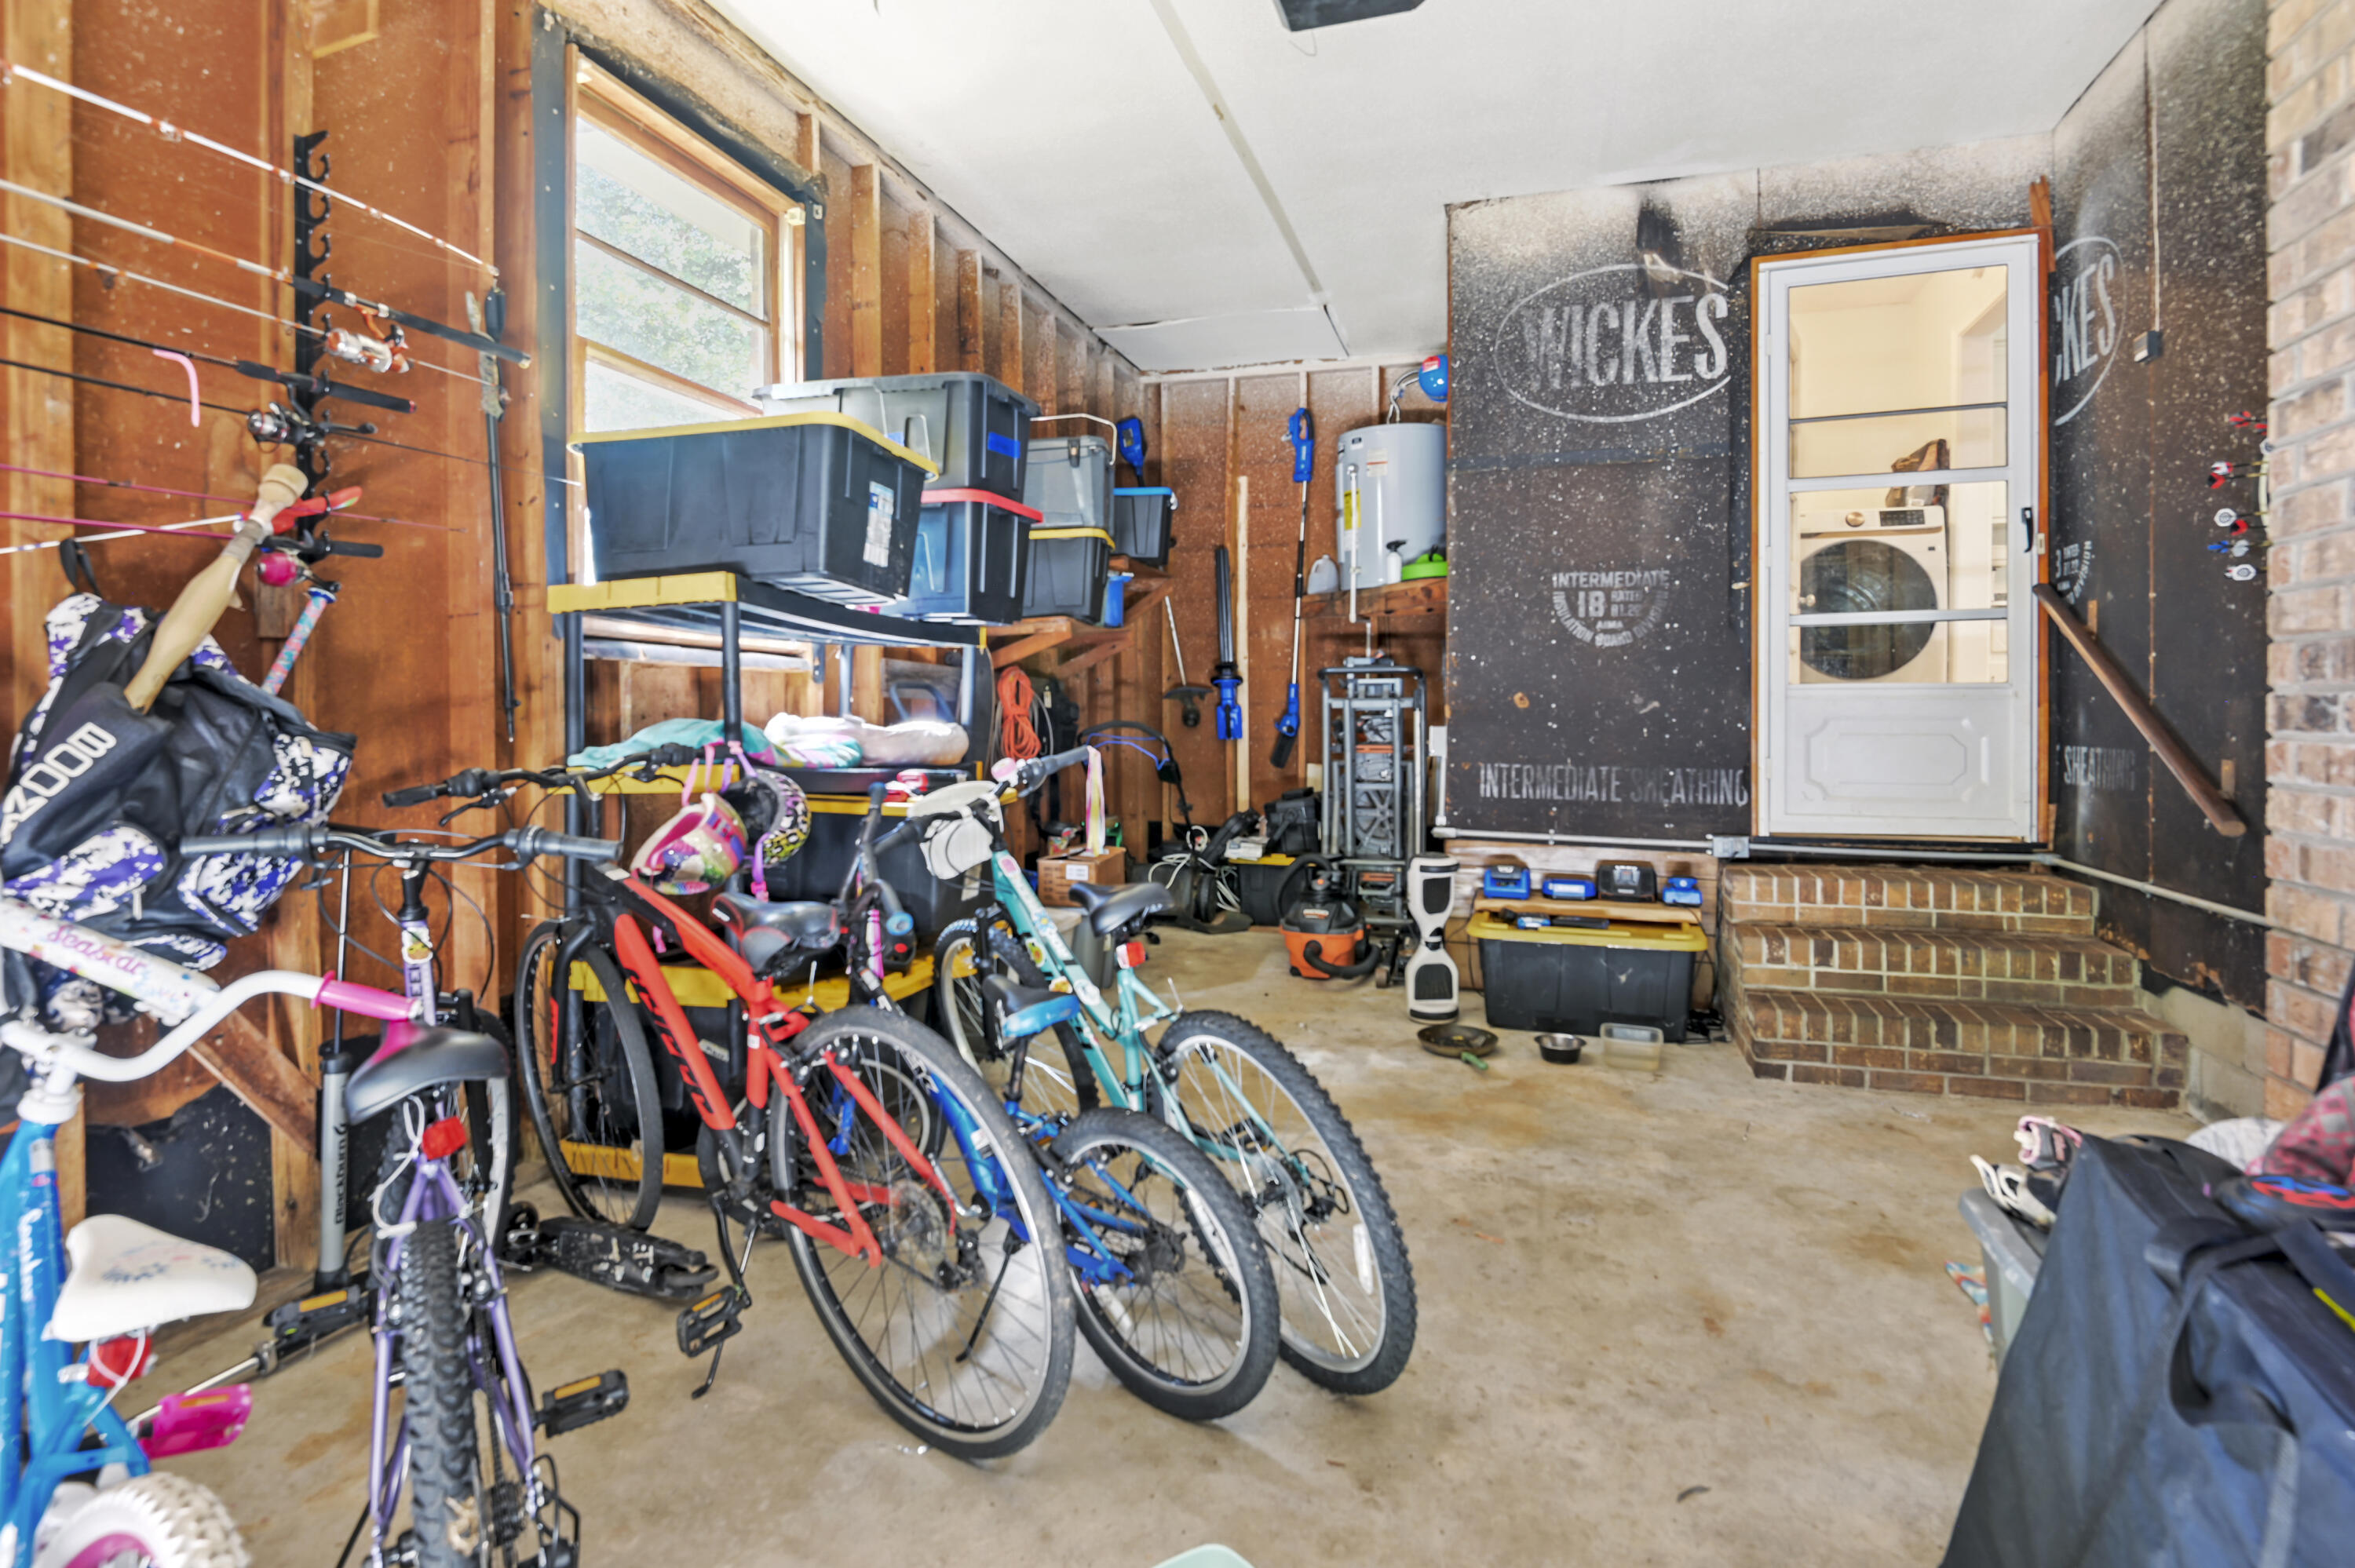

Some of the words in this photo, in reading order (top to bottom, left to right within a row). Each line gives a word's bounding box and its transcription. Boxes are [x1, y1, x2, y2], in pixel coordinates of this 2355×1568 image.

[1521, 294, 1729, 390] WICKES
[1552, 570, 1670, 589] INTERMEDIATE
[1552, 590, 1595, 643] INSULATION
[1594, 630, 1634, 647] BOARD
[1479, 763, 1623, 802] INTERMEDIATE
[1630, 767, 1749, 807] SHEATHING
[334, 1139, 347, 1225] Blackburn
